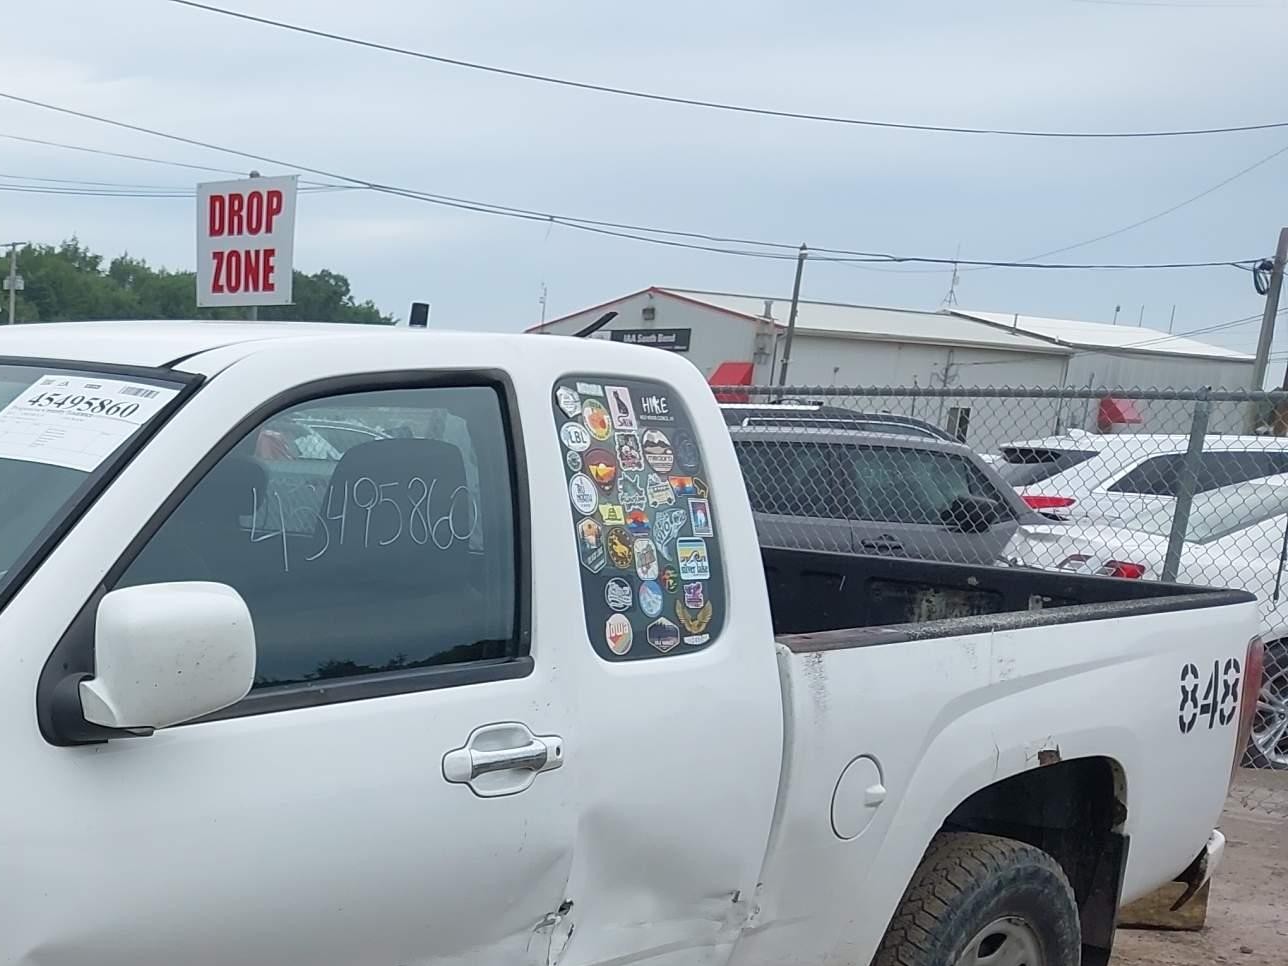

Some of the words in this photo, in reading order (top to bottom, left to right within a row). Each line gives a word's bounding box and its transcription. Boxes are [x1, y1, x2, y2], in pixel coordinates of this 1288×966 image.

[209, 190, 283, 237] DROP
[211, 248, 276, 293] ZONE
[28, 391, 140, 418] 45495860
[641, 395, 669, 414] HIKE
[568, 430, 588, 444] LBL
[1178, 657, 1242, 735] 848
